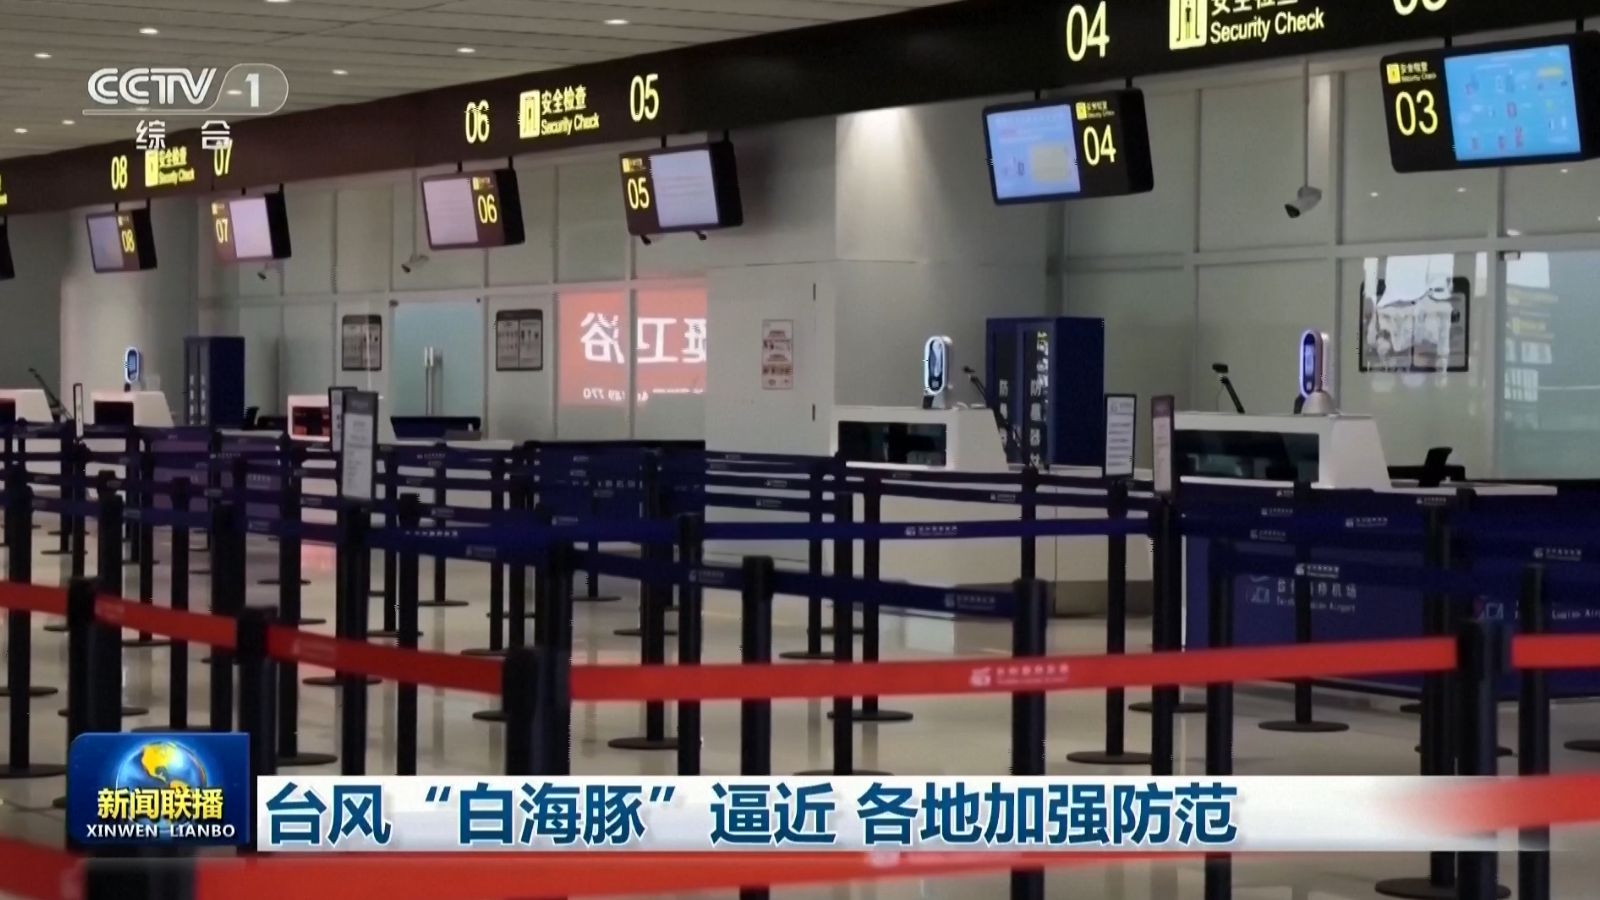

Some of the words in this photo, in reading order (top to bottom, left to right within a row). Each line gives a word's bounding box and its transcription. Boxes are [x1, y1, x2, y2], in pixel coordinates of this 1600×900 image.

[1066, 0, 1110, 62] 04
[1210, 15, 1271, 44] Security
[1274, 6, 1325, 35] Check
[541, 84, 587, 116] 安全检查
[629, 73, 660, 122] 05
[1395, 88, 1439, 136] 03
[464, 99, 490, 144] 06
[541, 115, 573, 136] Security
[573, 111, 600, 131] Check
[213, 138, 233, 176] 07
[1083, 124, 1117, 166] 04
[110, 154, 128, 191] 08
[477, 193, 498, 224] 06
[627, 176, 650, 210] 05
[120, 229, 136, 253] 08
[215, 217, 230, 244] 07
